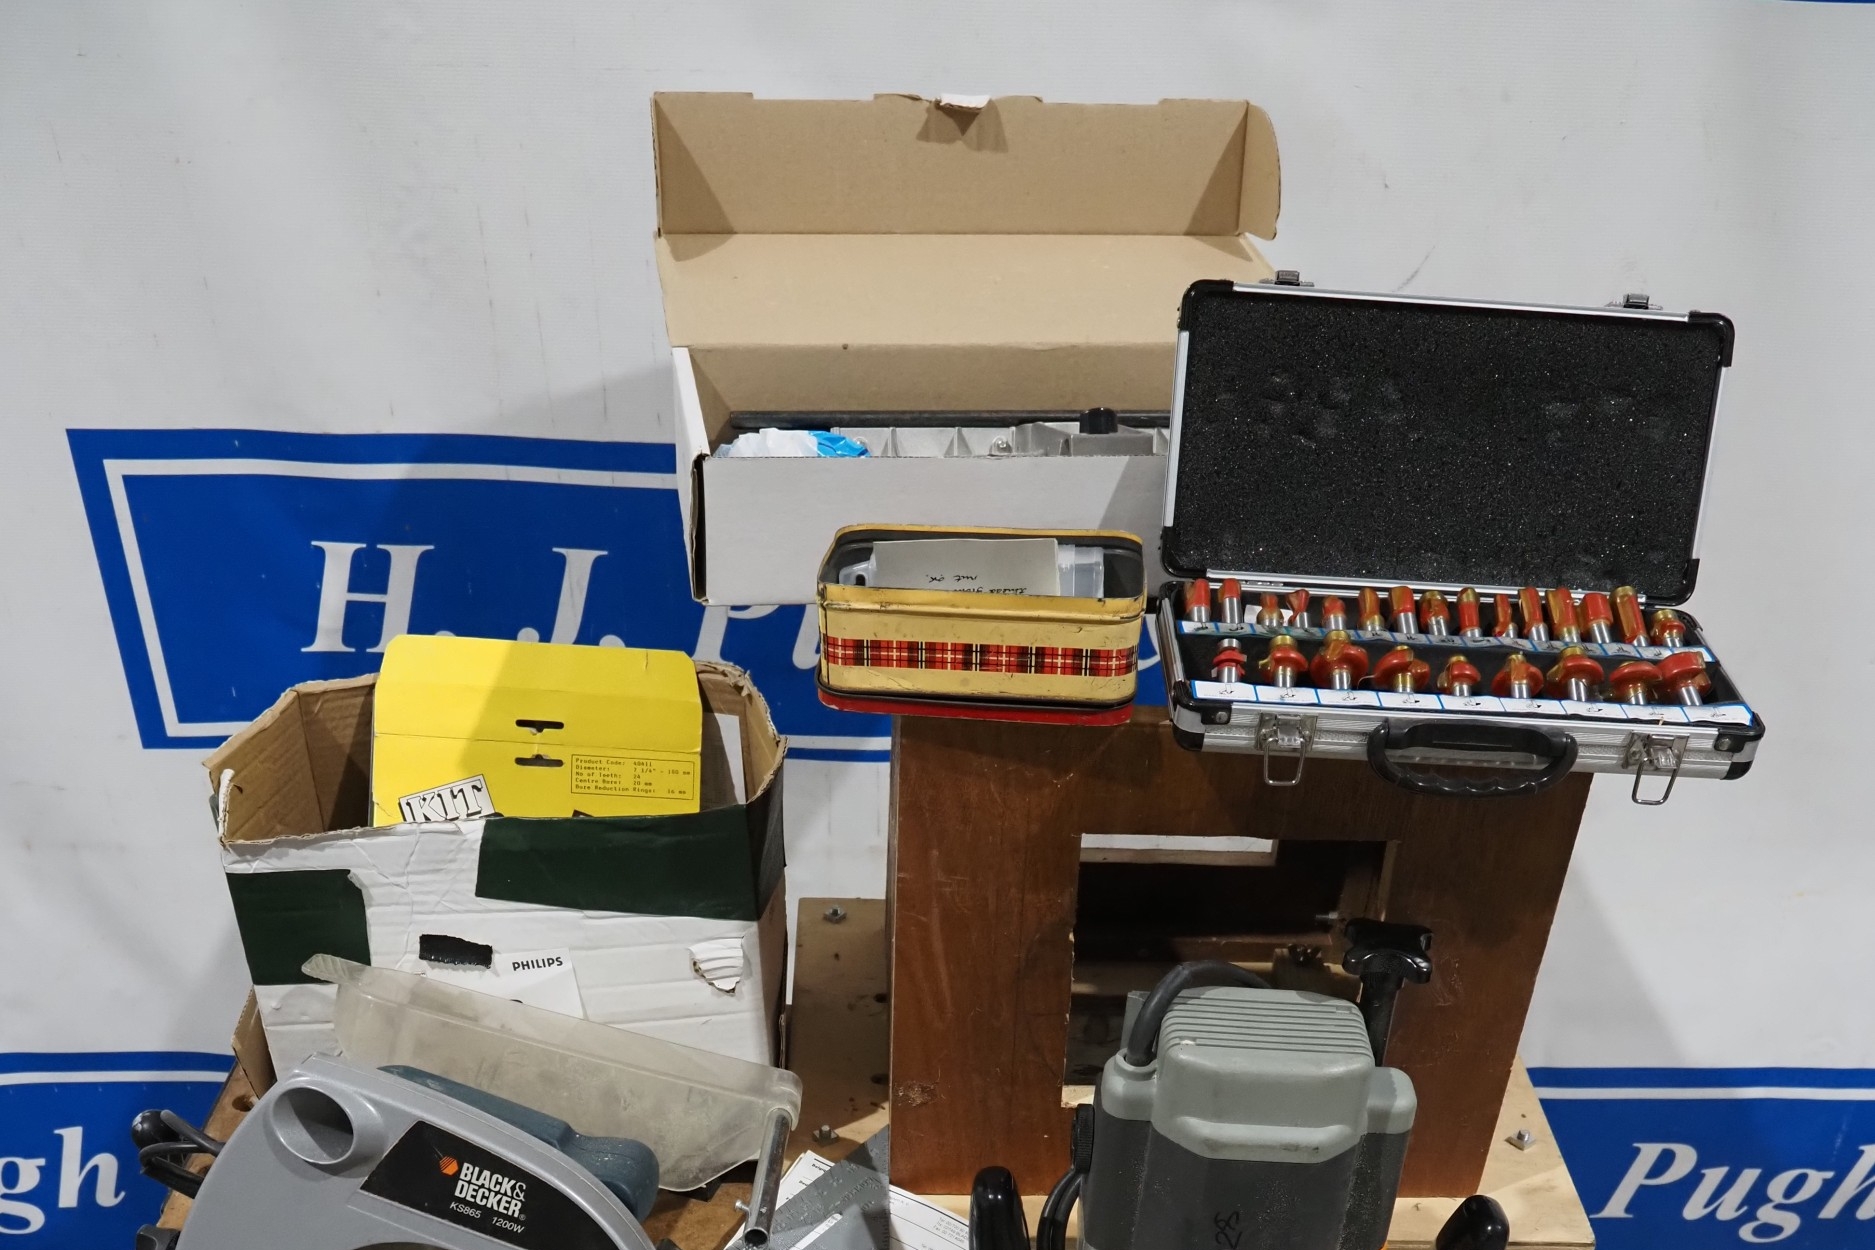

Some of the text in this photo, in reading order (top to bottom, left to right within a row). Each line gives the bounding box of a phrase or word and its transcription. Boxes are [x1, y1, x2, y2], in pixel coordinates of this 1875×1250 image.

[301, 540, 456, 652] H
[405, 778, 484, 823] KIT
[512, 956, 564, 972] PHILIPS
[449, 1201, 525, 1234] KS865 1200W
